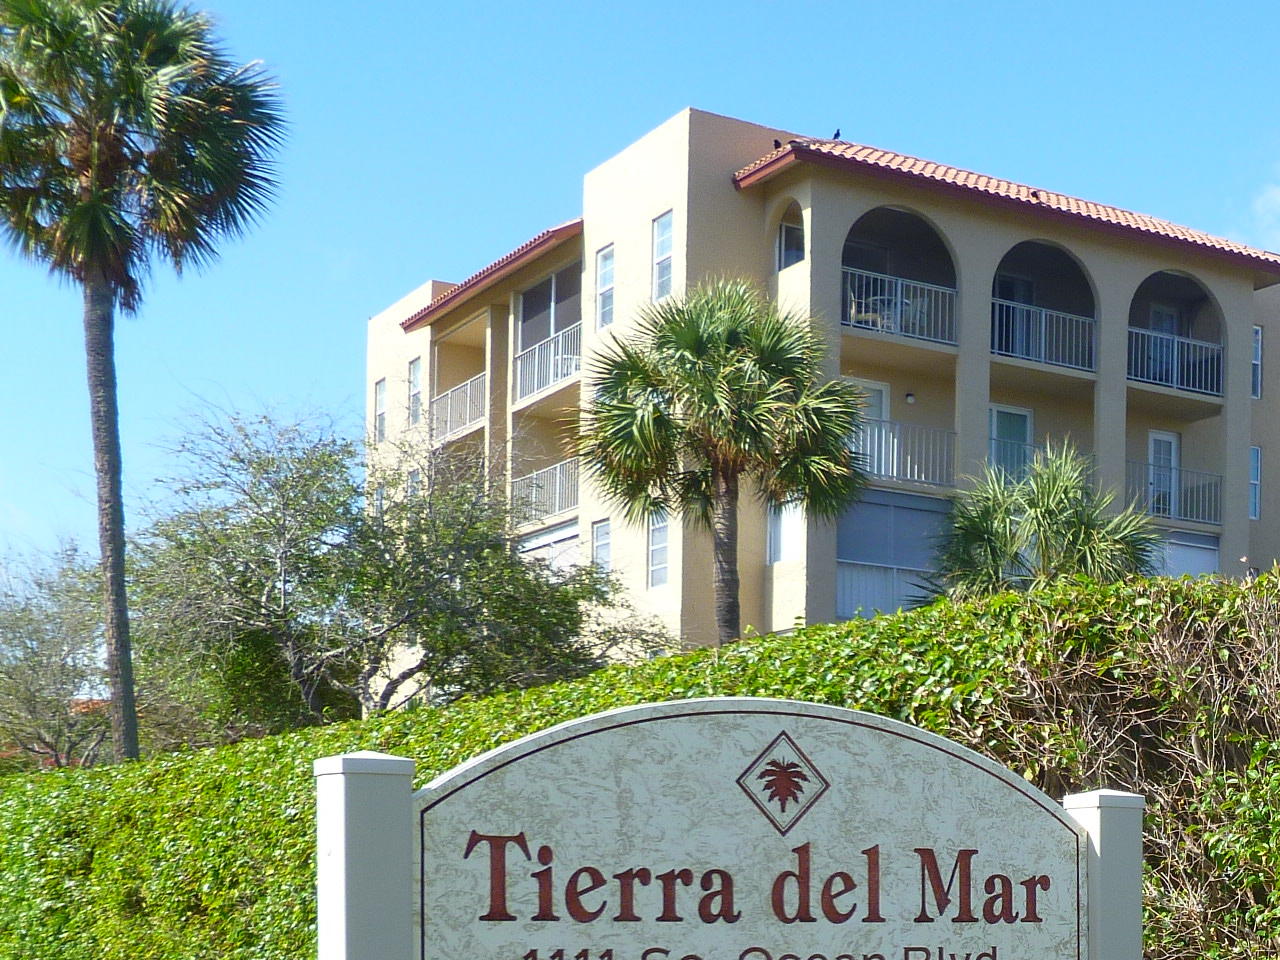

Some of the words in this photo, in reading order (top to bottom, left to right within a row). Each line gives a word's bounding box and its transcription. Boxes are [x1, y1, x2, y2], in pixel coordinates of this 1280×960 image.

[462, 829, 743, 924] Tierra
[770, 841, 887, 925] del
[912, 847, 1051, 926] Mar
